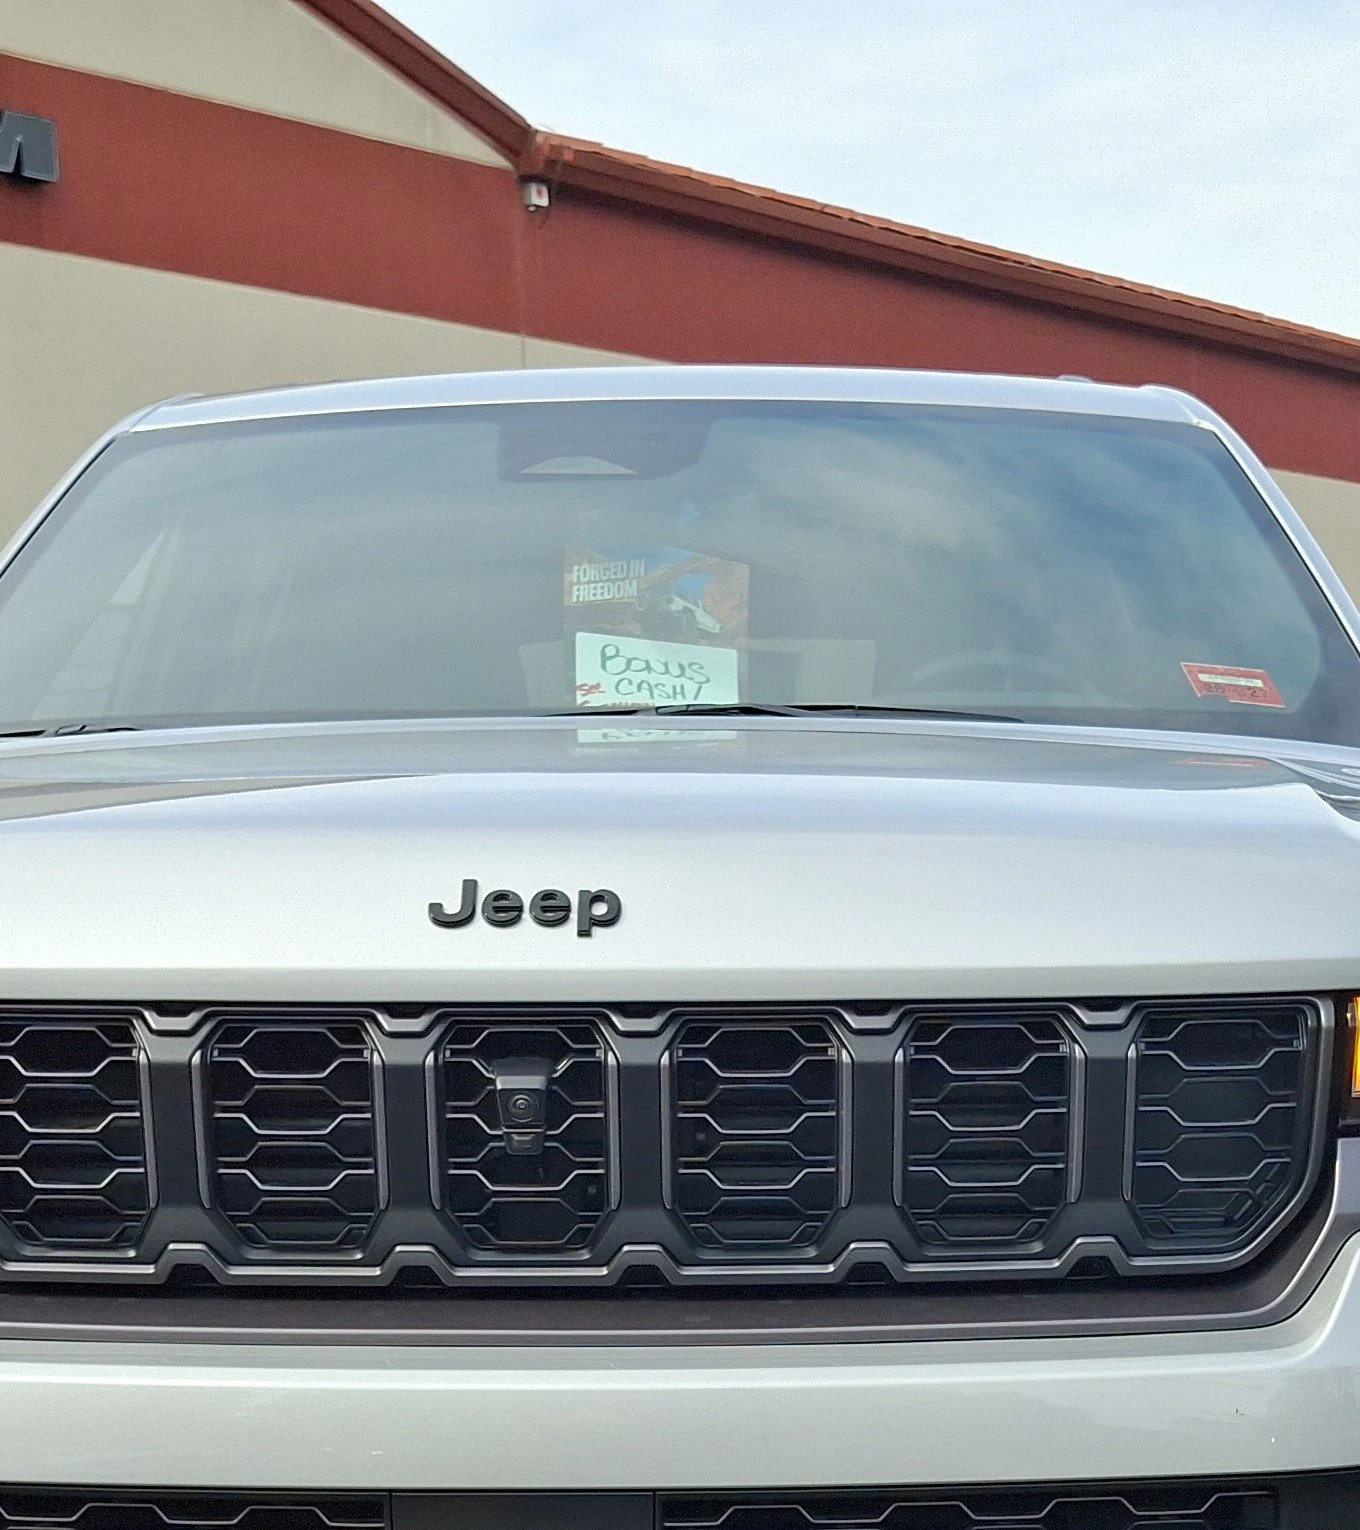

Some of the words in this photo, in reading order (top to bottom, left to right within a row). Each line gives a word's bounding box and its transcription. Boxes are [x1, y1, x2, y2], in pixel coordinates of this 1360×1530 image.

[573, 561, 627, 583] FORGED
[572, 579, 637, 603] FREEDOM
[428, 878, 622, 938] Jeep
